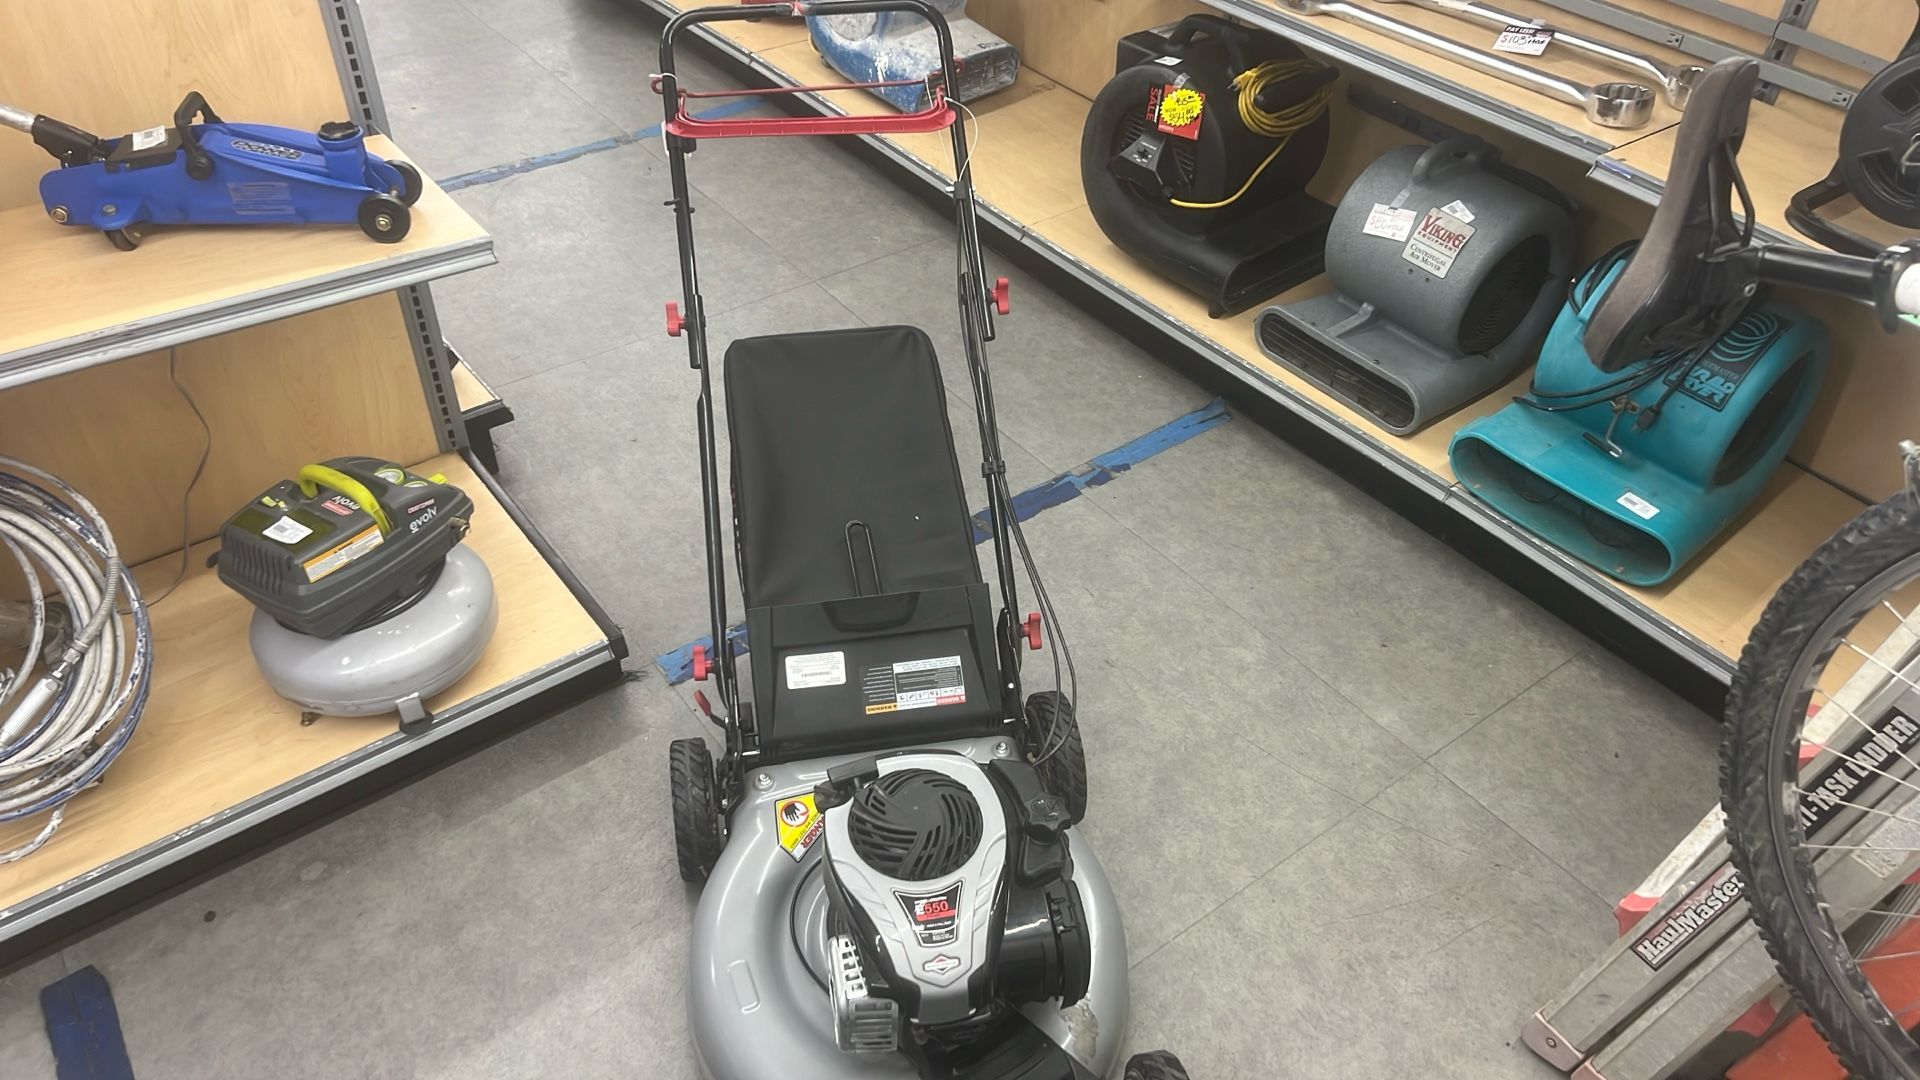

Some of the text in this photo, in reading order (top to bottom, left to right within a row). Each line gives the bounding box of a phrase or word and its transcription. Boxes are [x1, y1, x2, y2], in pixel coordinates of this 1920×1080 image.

[1146, 87, 1159, 121] SALE
[1417, 231, 1458, 254] EQUIPMENT
[409, 505, 437, 534] evolv
[1845, 715, 1919, 778] LADDER
[801, 815, 825, 850] ANGER
